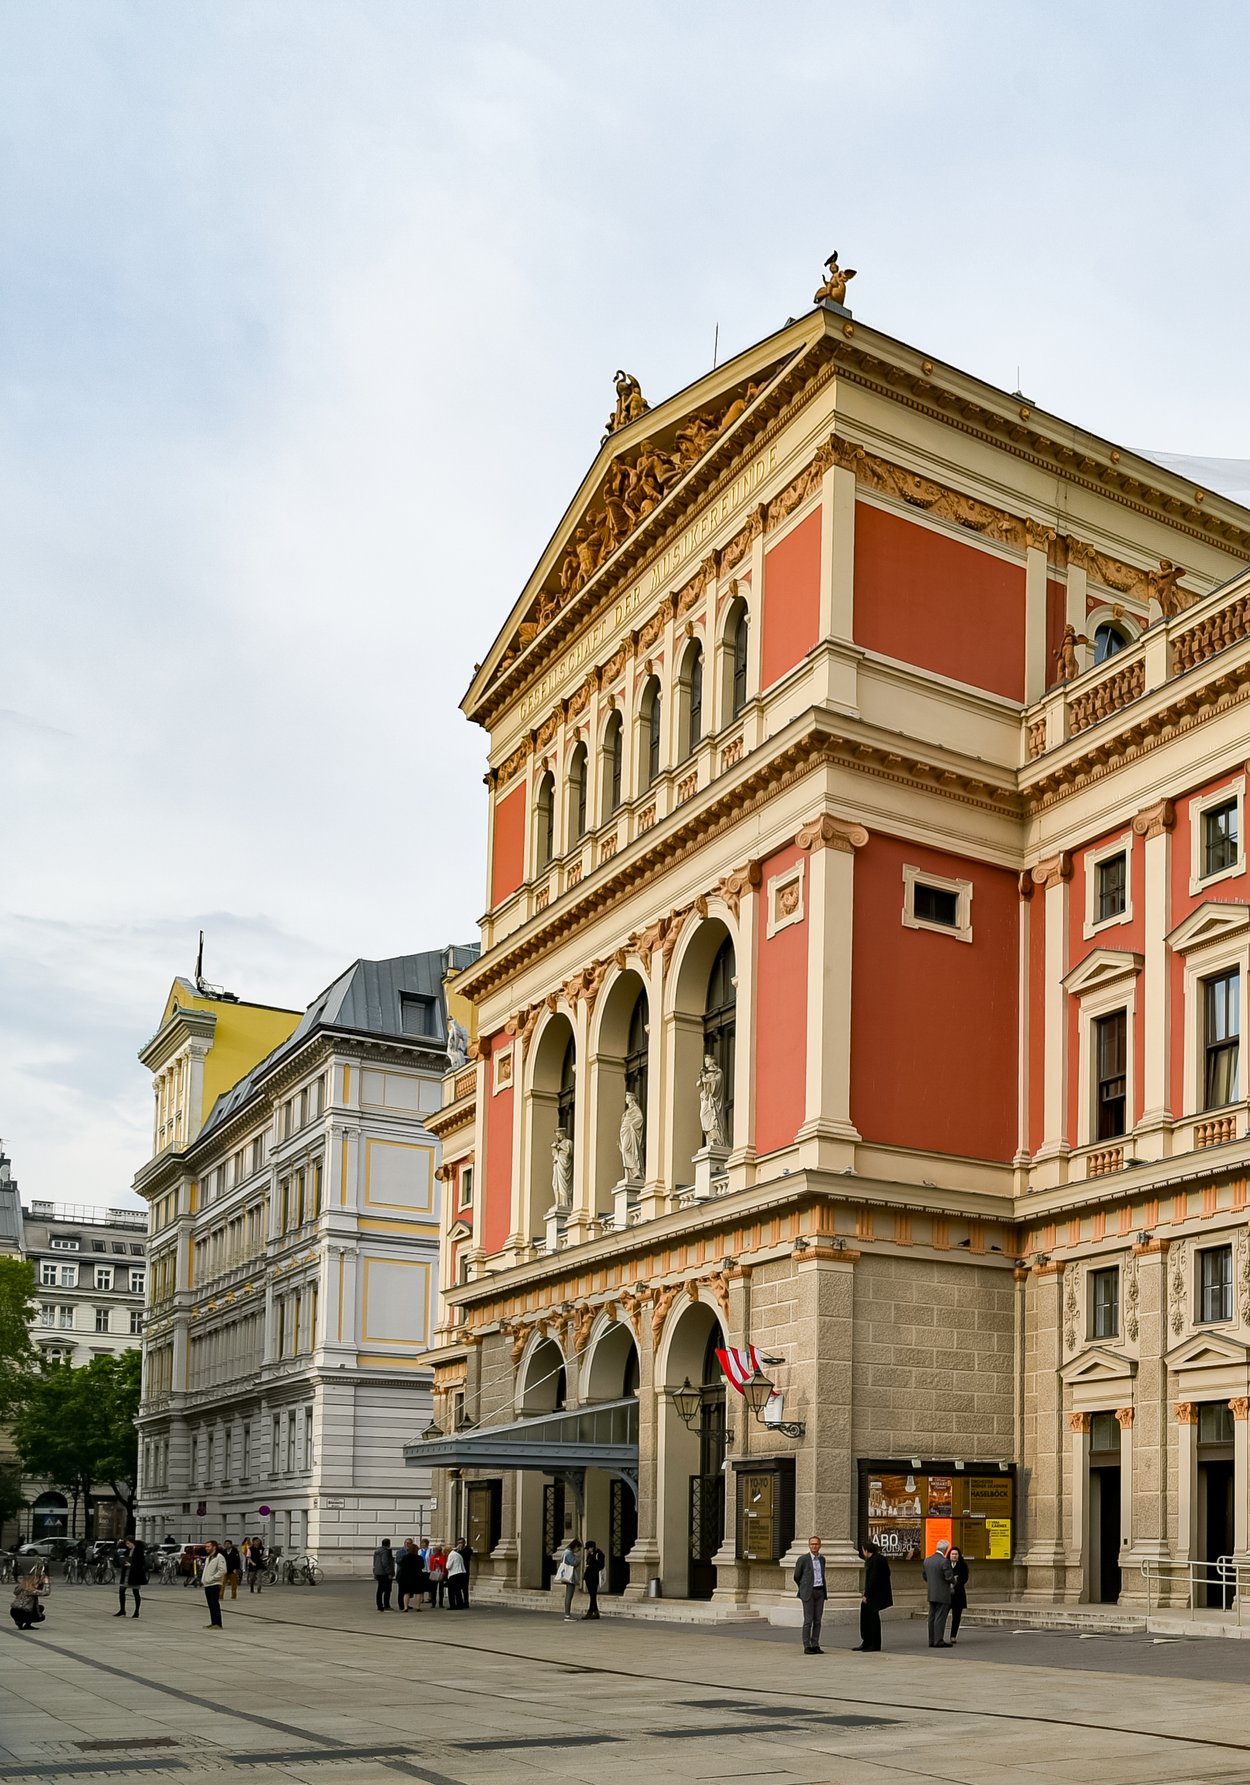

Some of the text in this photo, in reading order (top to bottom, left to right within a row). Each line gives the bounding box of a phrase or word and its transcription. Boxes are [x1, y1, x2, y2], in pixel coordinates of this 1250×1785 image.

[750, 1477, 769, 1488] YO-YO
[971, 1490, 1009, 1498] HASELBÖCK
[872, 1533, 899, 1547] ABO
